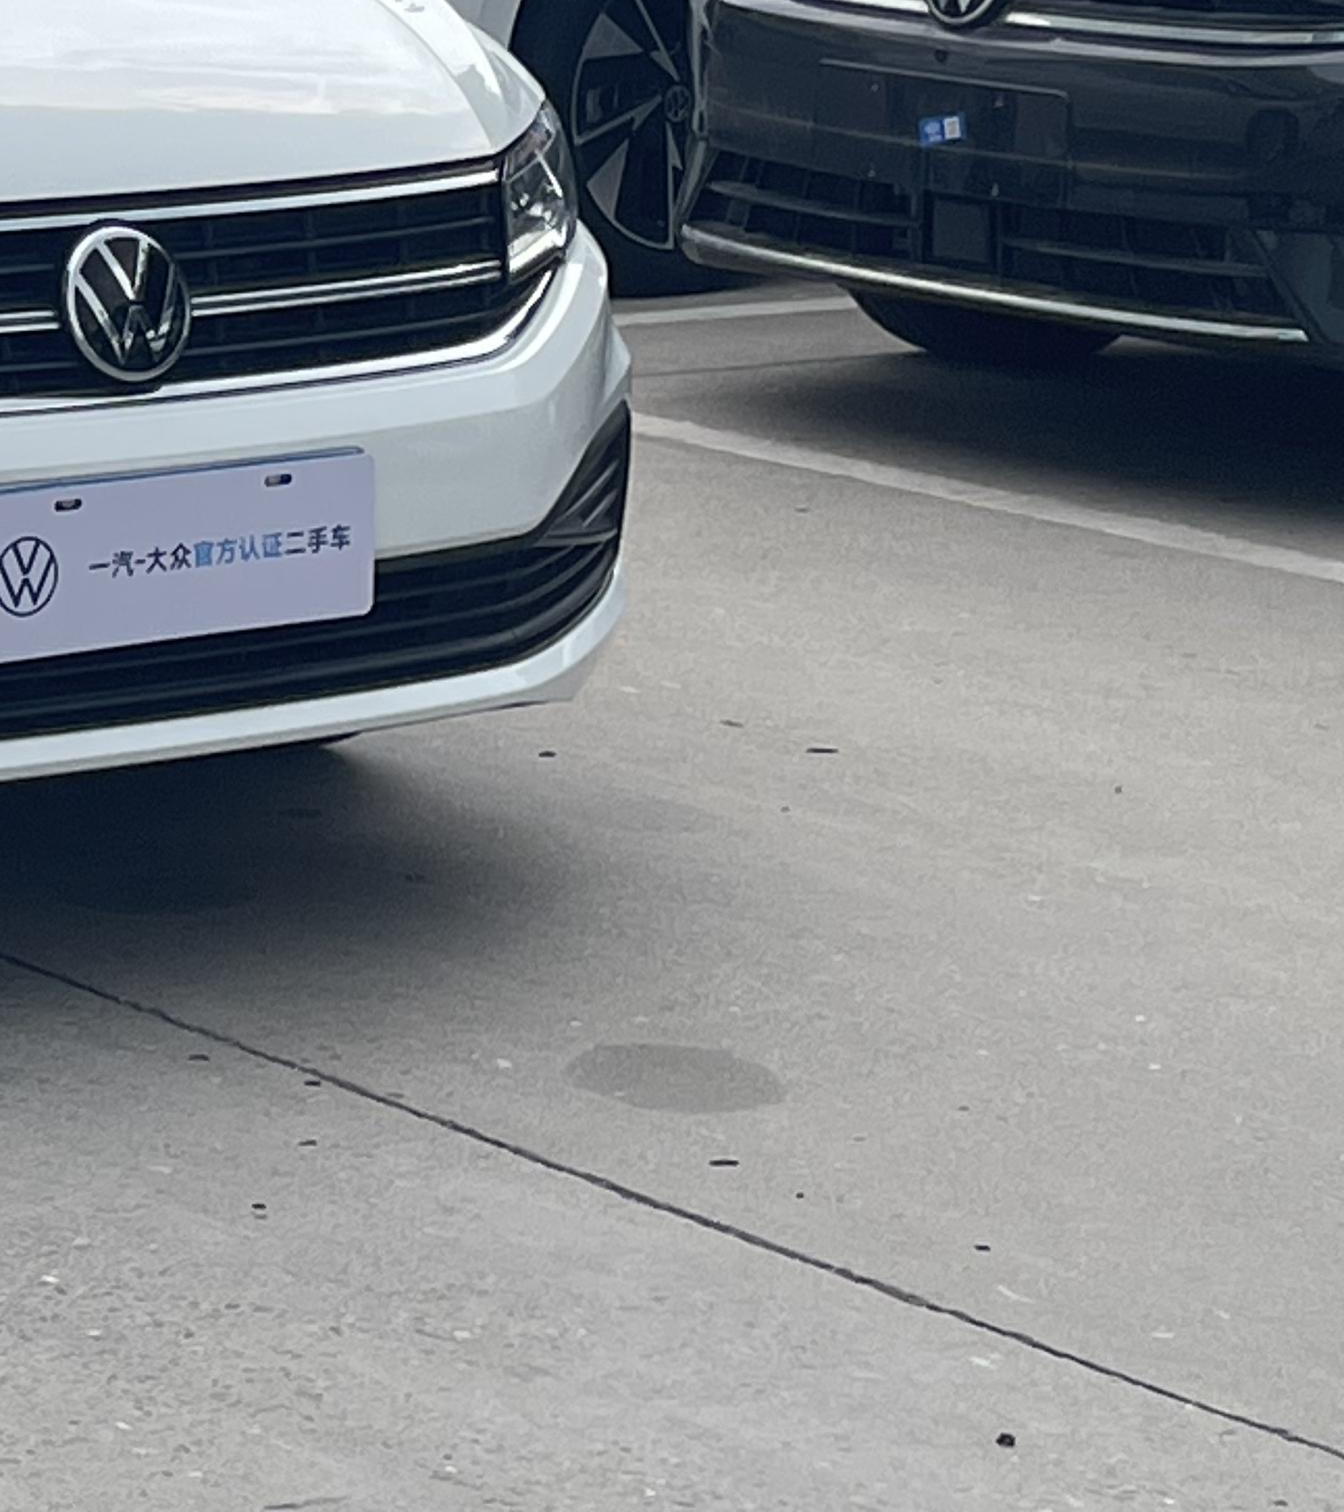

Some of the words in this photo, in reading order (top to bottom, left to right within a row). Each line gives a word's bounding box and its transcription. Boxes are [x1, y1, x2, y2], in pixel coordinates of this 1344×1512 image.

[88, 523, 352, 579] 一汽-大众官方认证二手车
